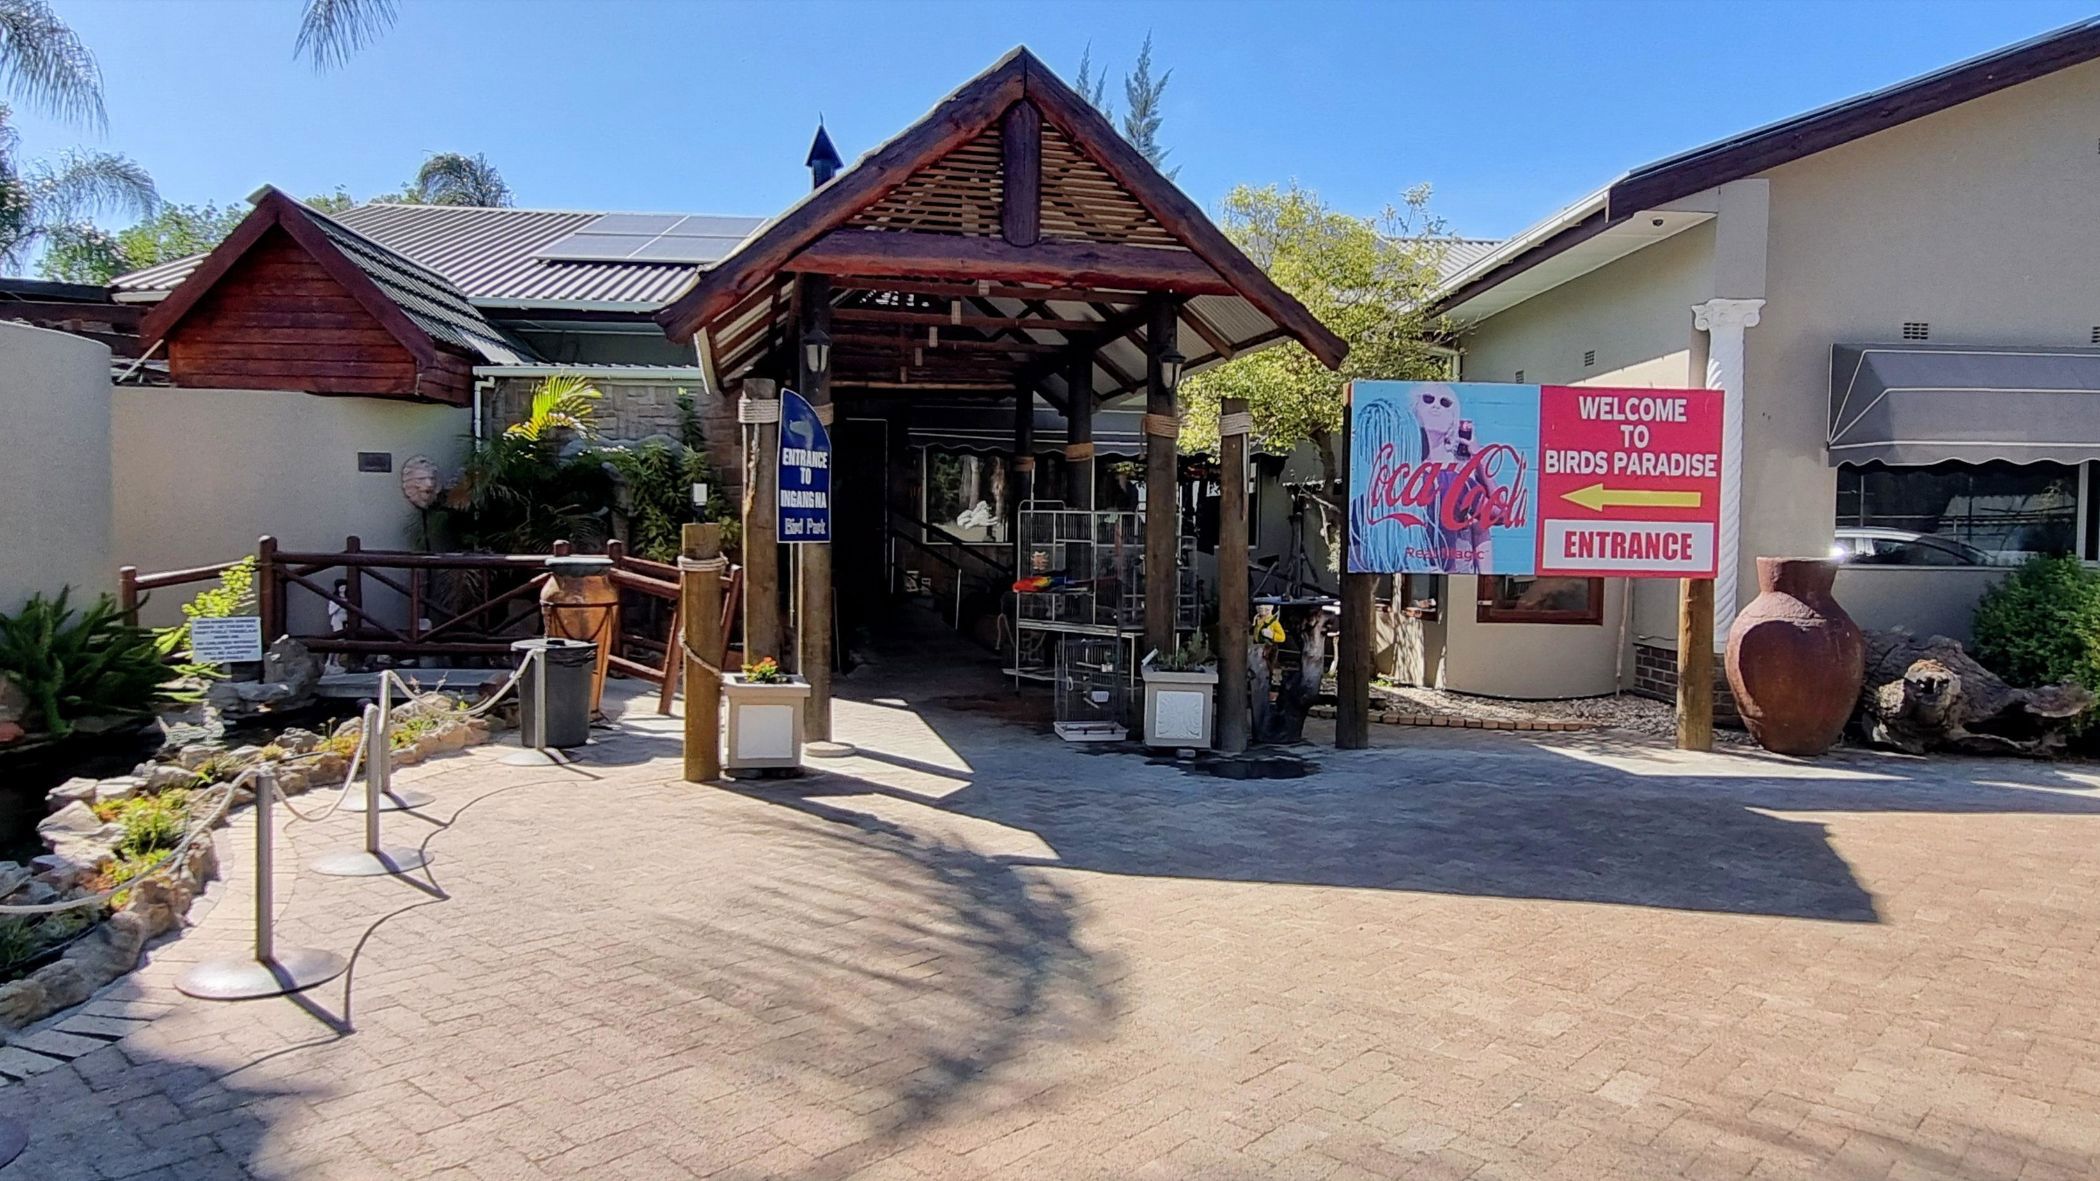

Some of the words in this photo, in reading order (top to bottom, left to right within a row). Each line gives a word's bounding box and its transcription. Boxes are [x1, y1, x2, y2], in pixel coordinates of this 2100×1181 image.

[1579, 396, 1687, 422] WELCOME
[1620, 425, 1649, 448] TO
[782, 448, 828, 468] ENTRANCE
[1545, 450, 1608, 475] BIRDS
[1613, 451, 1718, 478] PARADISE
[800, 467, 811, 484] TO
[784, 518, 803, 534] Bird
[806, 518, 826, 534] Park
[1441, 547, 1484, 562] agc
[1564, 531, 1692, 560] ENTRANCE
